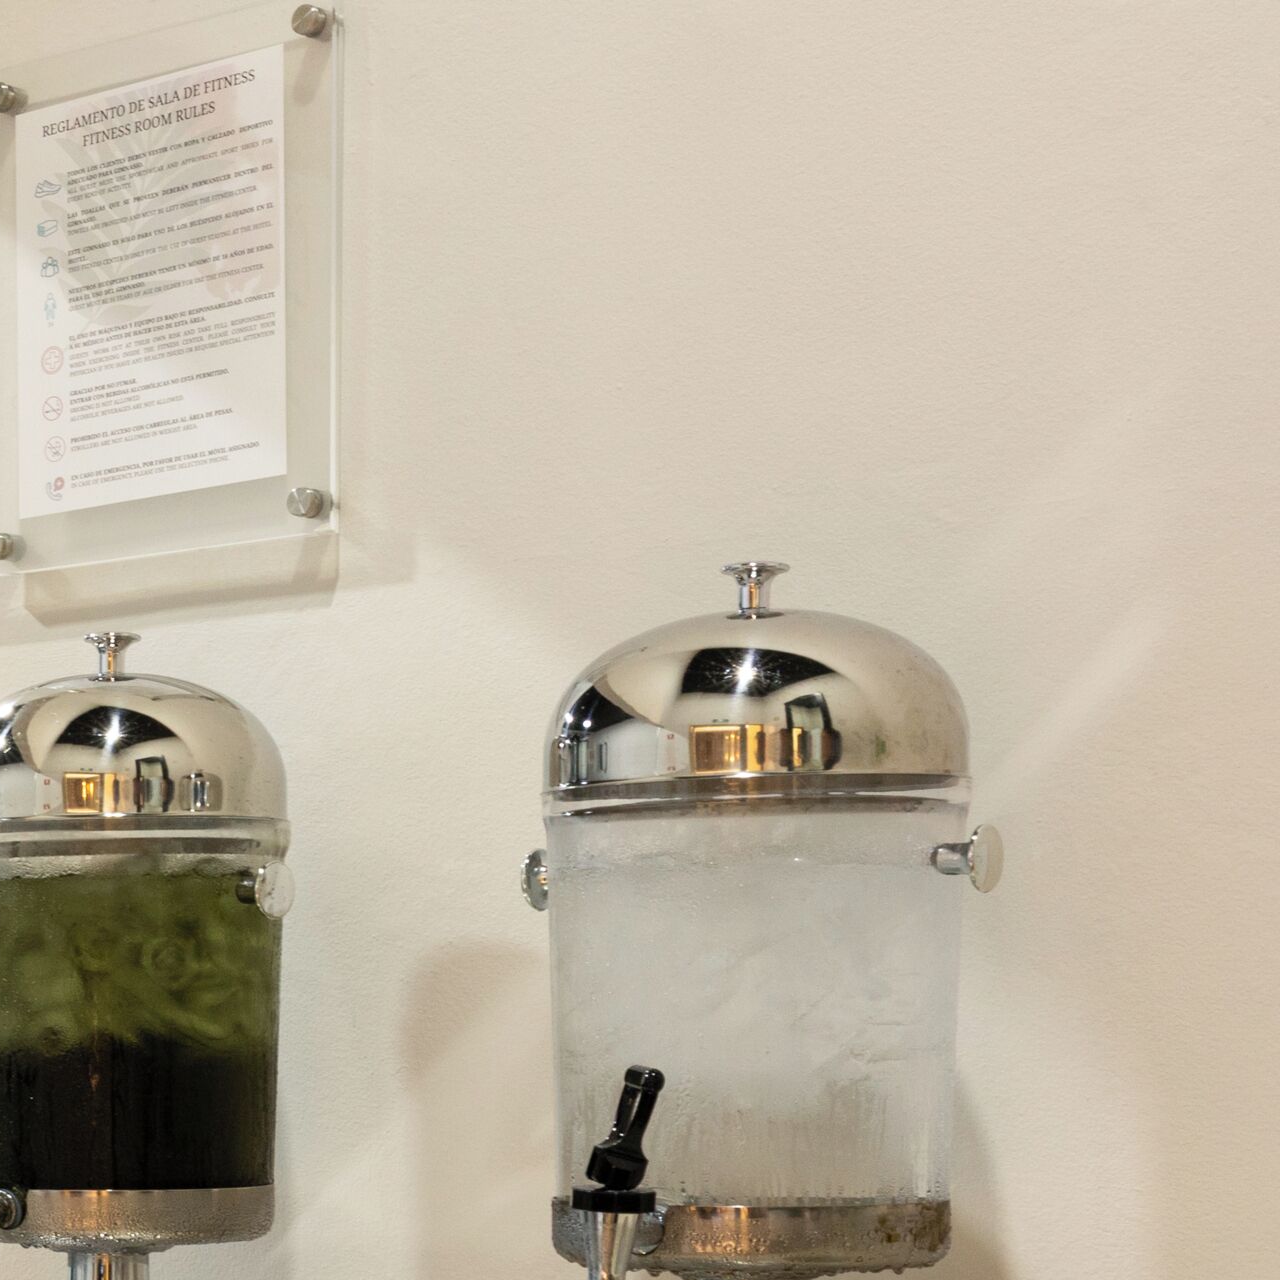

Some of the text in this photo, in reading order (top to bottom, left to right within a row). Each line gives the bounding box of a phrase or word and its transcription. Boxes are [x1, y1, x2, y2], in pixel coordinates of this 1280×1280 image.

[42, 68, 255, 137] REGLAMENTO DE SALA DE FITNESS
[82, 100, 215, 147] FITNESS ROOM RULES
